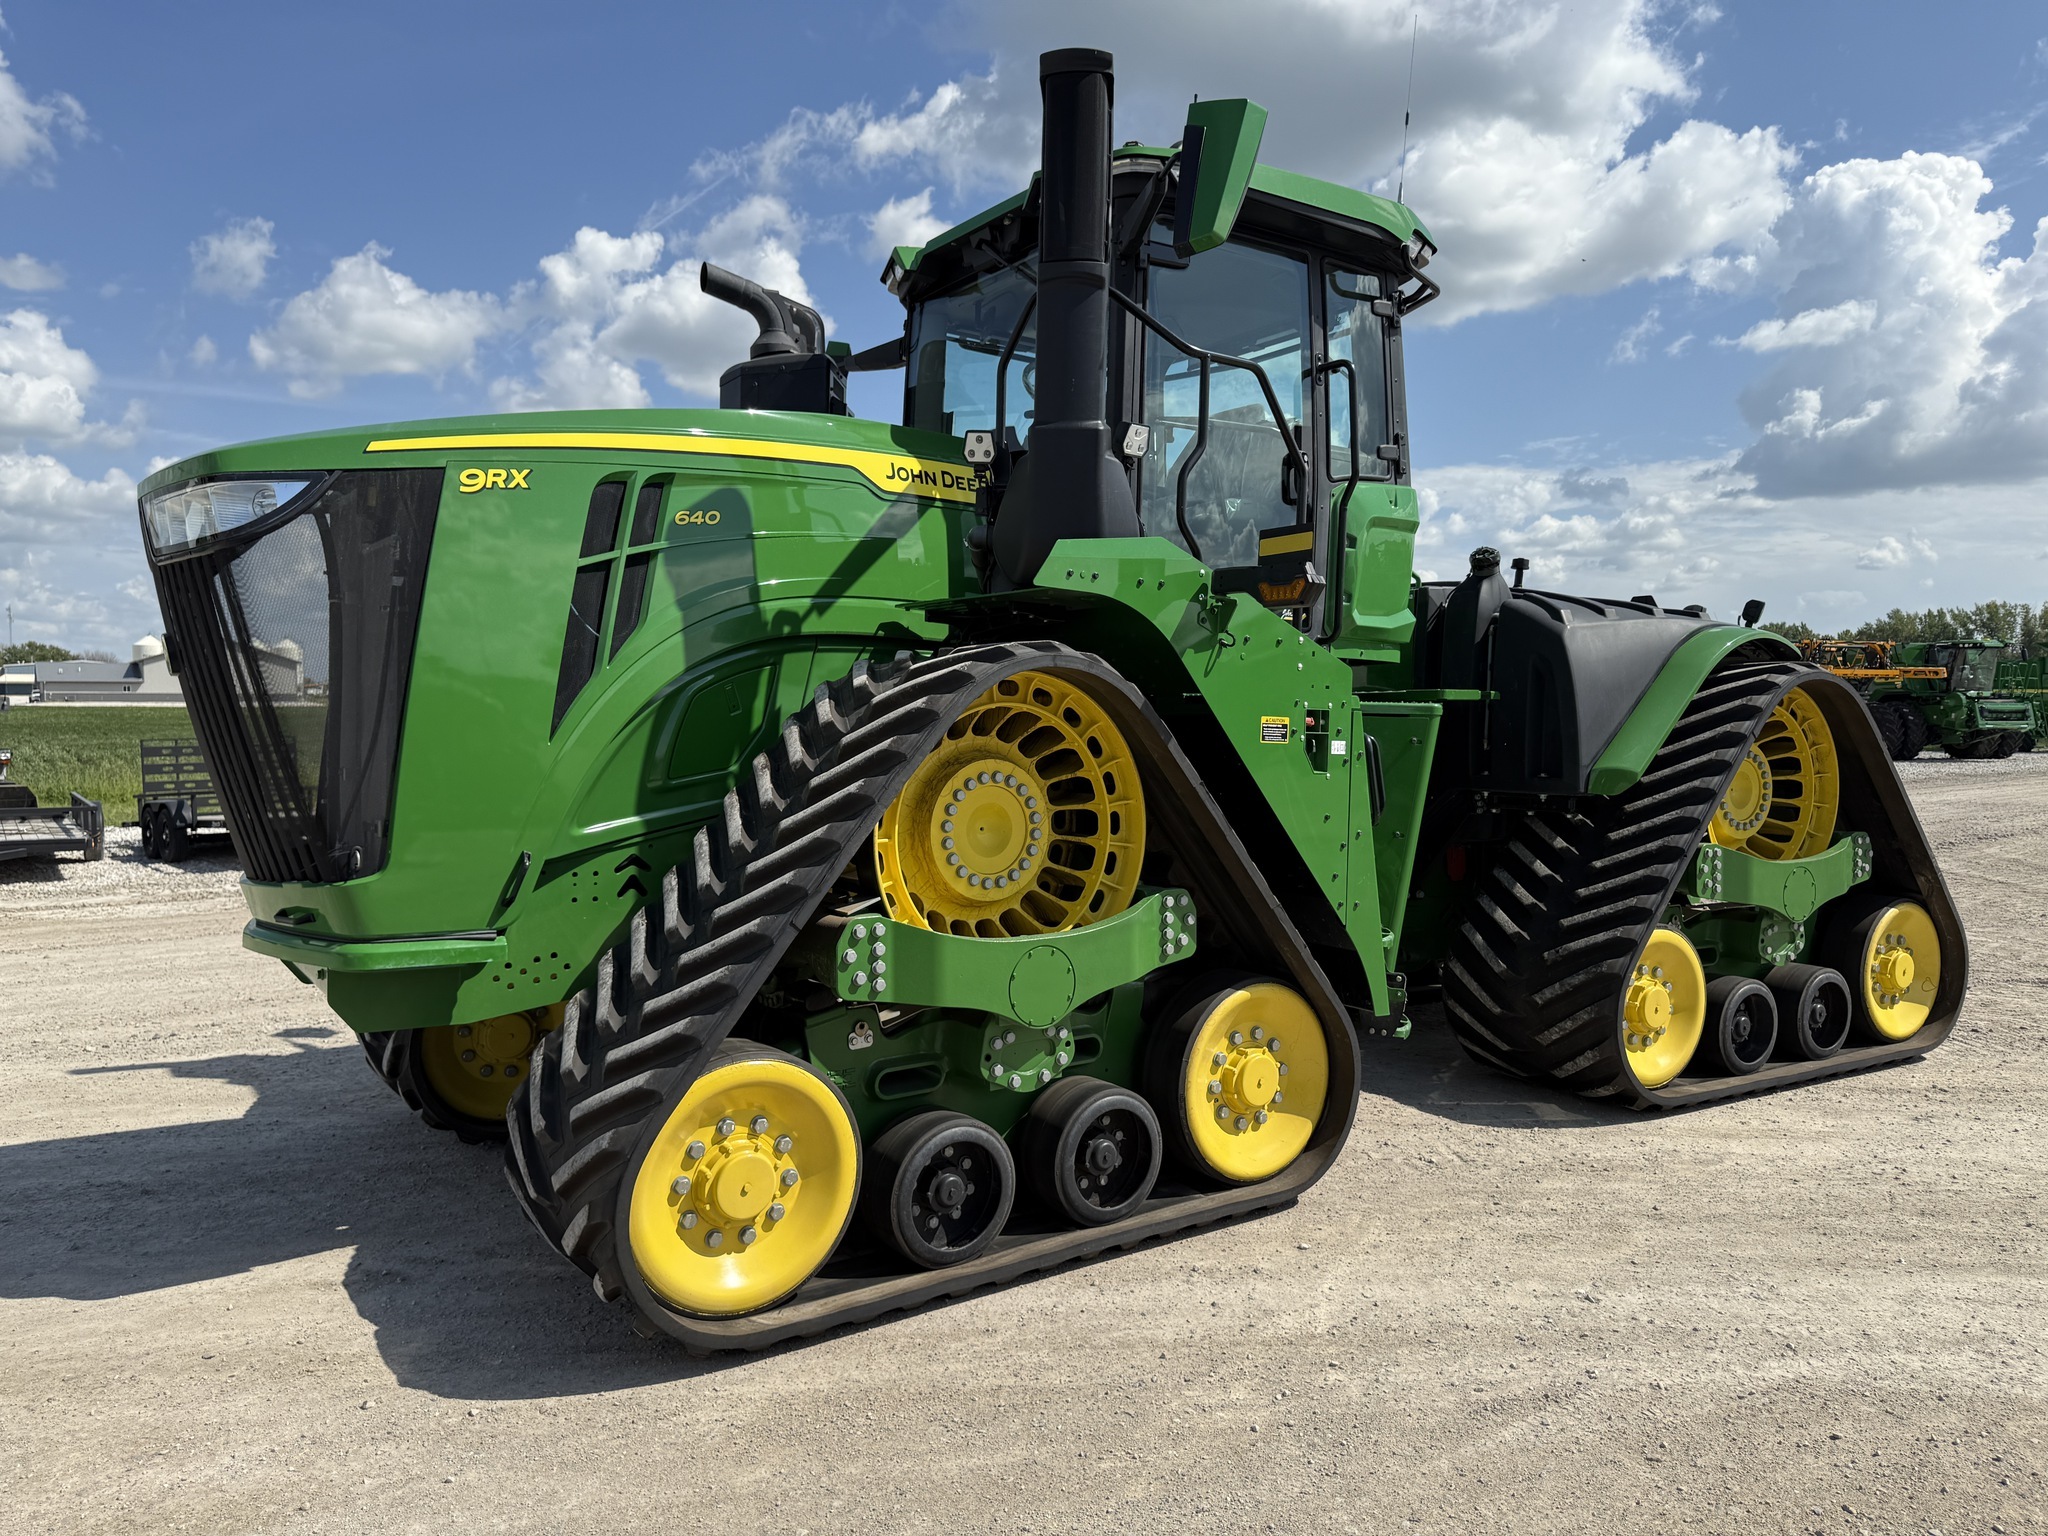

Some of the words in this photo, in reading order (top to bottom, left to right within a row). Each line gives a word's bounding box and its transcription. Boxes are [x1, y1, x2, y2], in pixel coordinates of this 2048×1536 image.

[459, 468, 532, 494] 9RX
[886, 462, 938, 487] JOHN
[674, 510, 721, 525] 640
